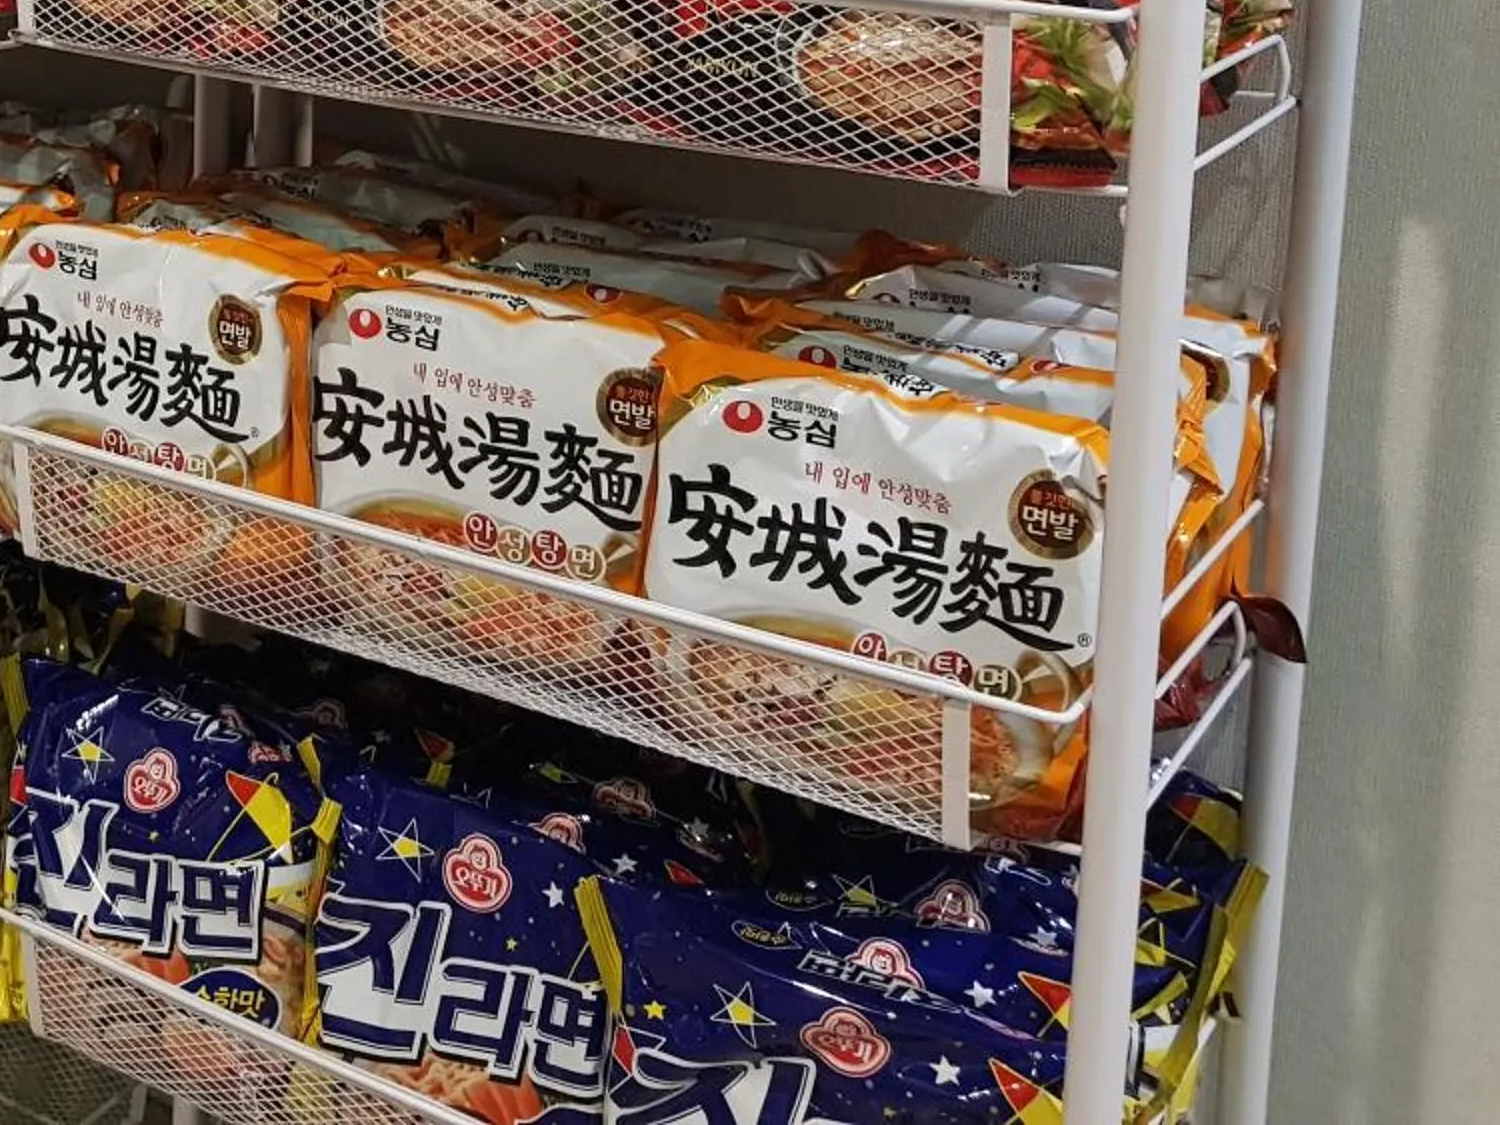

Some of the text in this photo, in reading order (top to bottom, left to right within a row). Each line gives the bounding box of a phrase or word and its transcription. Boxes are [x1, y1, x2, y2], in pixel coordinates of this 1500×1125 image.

[57, 251, 99, 281] 농심
[76, 291, 92, 310] 내
[385, 317, 440, 352] 농심
[413, 362, 537, 409] 내 입에 안성맞춤
[609, 398, 657, 431] 면발
[770, 396, 840, 422] 인생을 맛있게
[312, 366, 644, 533] 安城湯麵
[767, 410, 838, 450] 농심
[804, 460, 953, 515] 내 입에 안성맞춤
[1021, 504, 1080, 542] 면발
[467, 515, 600, 578] 안성탕면
[667, 463, 1076, 653] 安城湯麵
[312, 892, 610, 1099] 진라면
